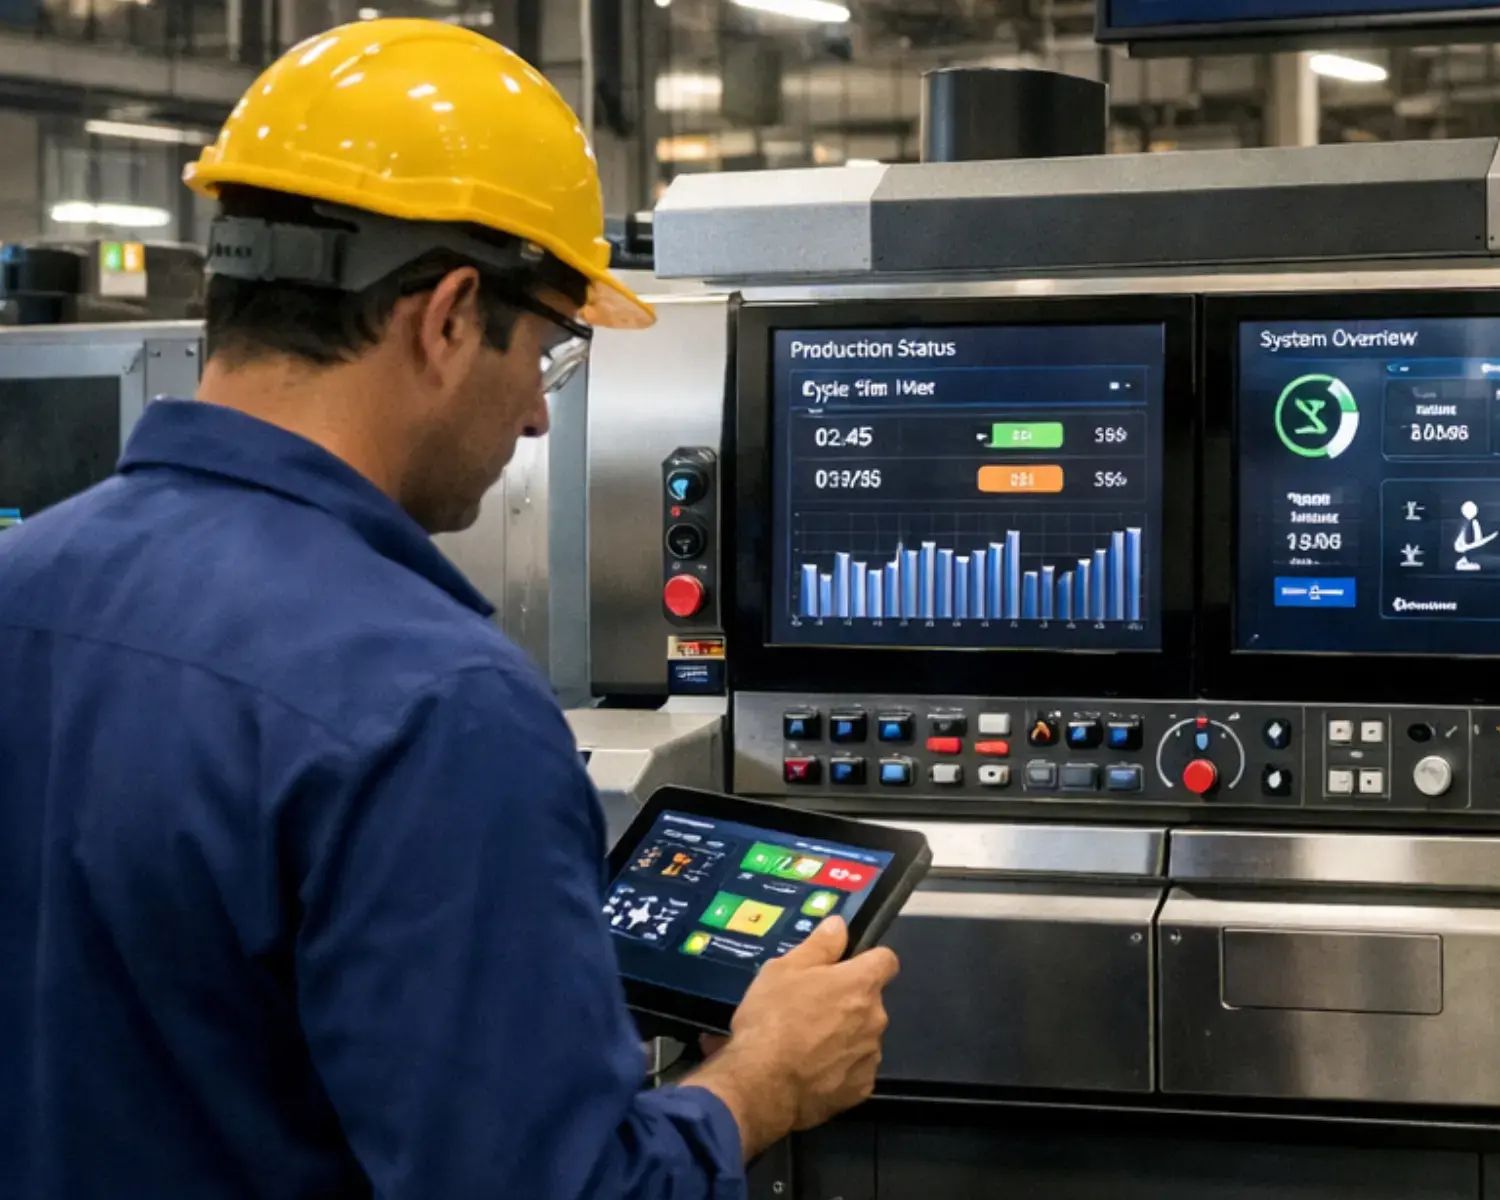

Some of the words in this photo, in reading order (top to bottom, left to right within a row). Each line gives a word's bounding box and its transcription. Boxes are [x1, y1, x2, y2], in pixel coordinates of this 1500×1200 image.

[790, 339, 893, 359] Production
[898, 338, 956, 357] Status
[1260, 330, 1327, 351] System
